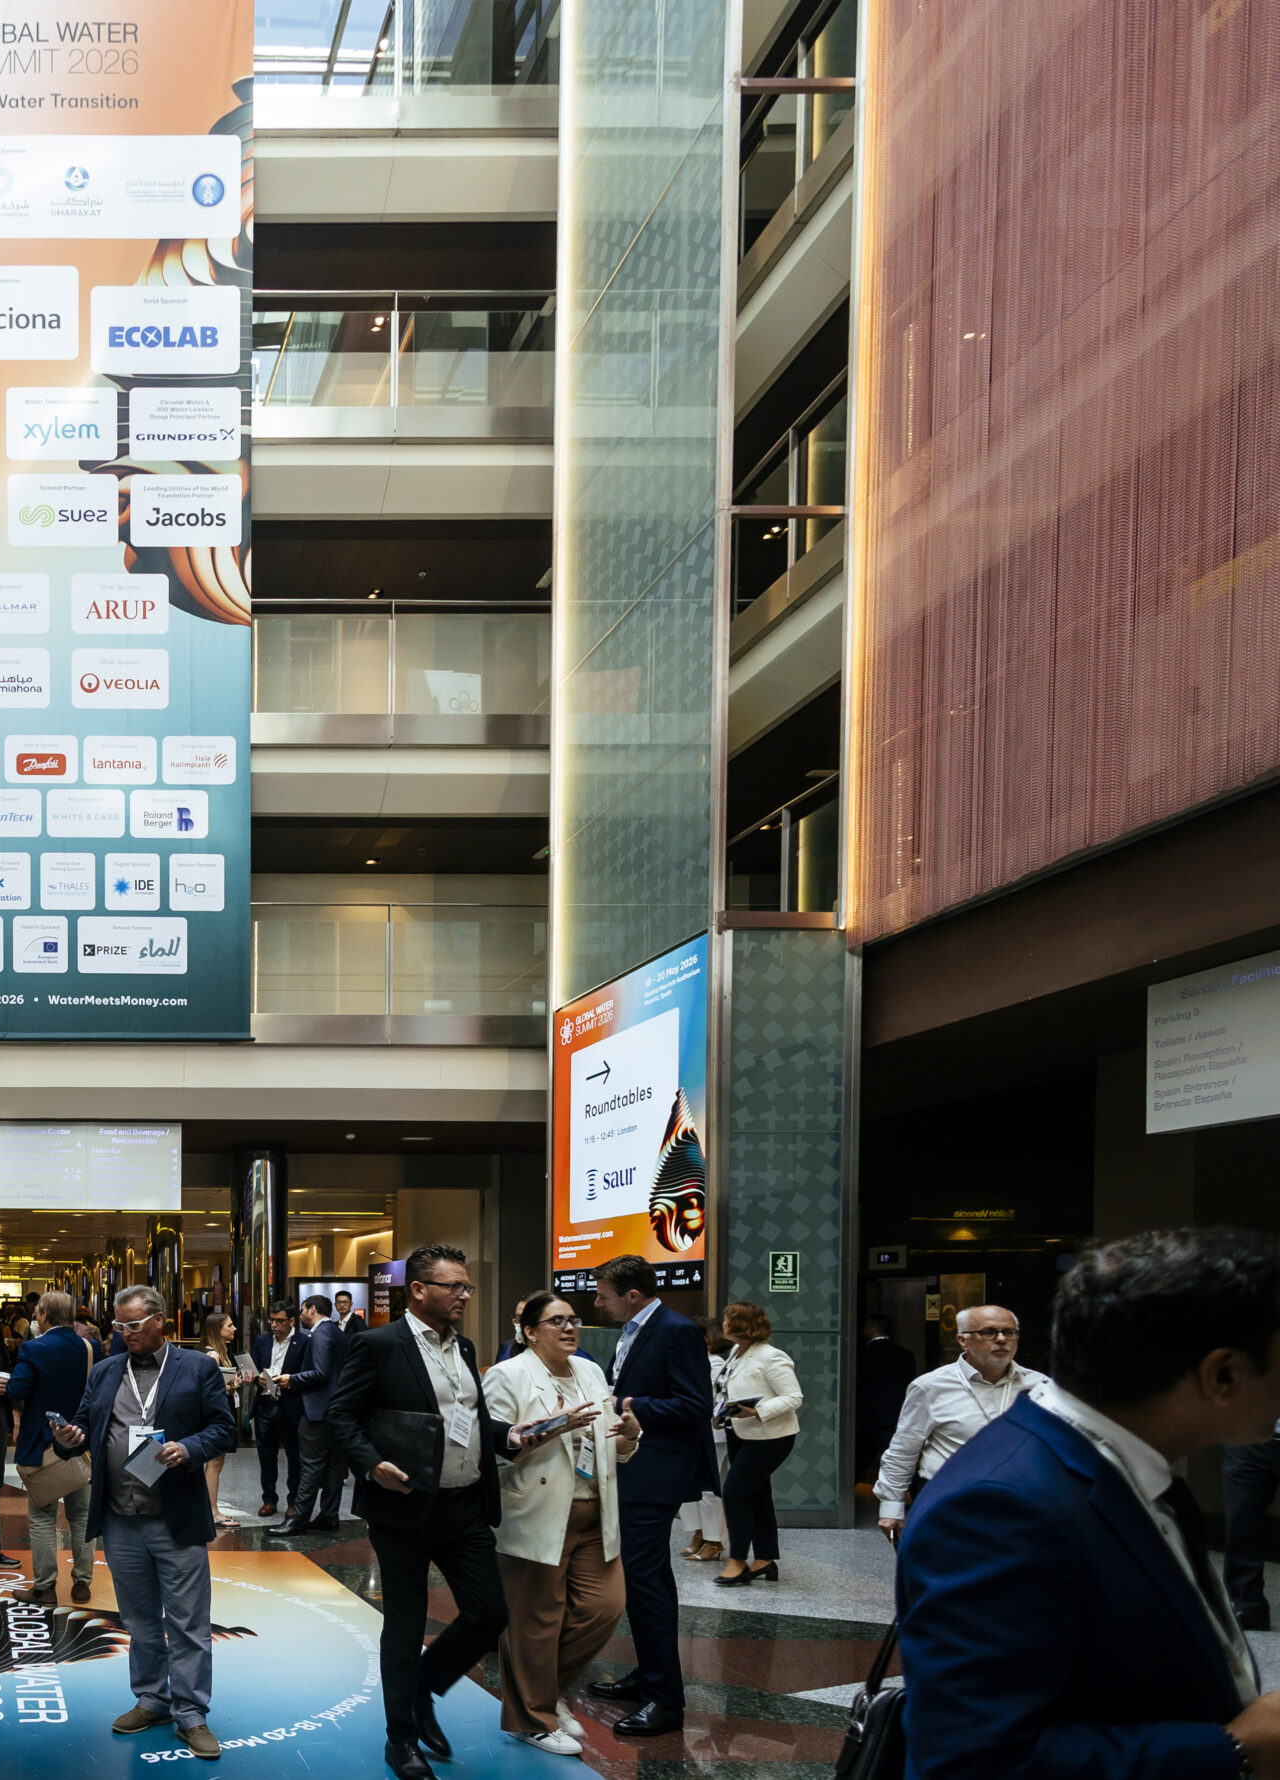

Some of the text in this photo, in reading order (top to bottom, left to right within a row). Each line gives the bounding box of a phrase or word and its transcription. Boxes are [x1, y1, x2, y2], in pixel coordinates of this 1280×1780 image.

[56, 22, 139, 44] WATER
[68, 49, 139, 75] 2026
[51, 92, 139, 109] Transition
[50, 209, 102, 217] SHARAKAT
[108, 325, 219, 348] ECOLAB
[23, 415, 101, 446] xylem
[136, 433, 218, 441] GRUNDFOS
[63, 484, 86, 492] Partner
[145, 507, 227, 527] Jacobs
[85, 600, 156, 620] ARUP
[103, 678, 161, 690] VEOLIA
[22, 756, 59, 772] Danfoss
[92, 757, 142, 770] lantania
[170, 761, 211, 769] italimpianti
[143, 811, 173, 819] Roland
[143, 819, 172, 829] Berger
[58, 882, 90, 890] THALES
[134, 879, 155, 890] IDE
[657, 971, 665, 983] 20
[666, 965, 679, 979] May
[680, 953, 698, 969] 2026
[48, 994, 188, 1008] WaterMeetsMoney.com
[575, 999, 614, 1025] GLOBAL WATER
[1154, 1008, 1200, 1026] Parking 3
[575, 1009, 614, 1037] SUMMIT 2026
[1154, 1027, 1228, 1049] Toilets Aseos
[1153, 1046, 1236, 1070] Spain Reception
[1209, 1055, 1248, 1071] España
[1153, 1078, 1229, 1101] Spain Entrance
[584, 1083, 653, 1119] Roundtables
[1154, 1090, 1233, 1112] Entrada España
[99, 1128, 118, 1136] Food
[600, 1129, 615, 1141] 12:45
[617, 1123, 638, 1137] London
[602, 1165, 637, 1190] saur
[6, 1606, 69, 1724] GLOBAL WATER
[311, 1693, 373, 1725] Madrid,
[139, 1748, 197, 1764] 026
